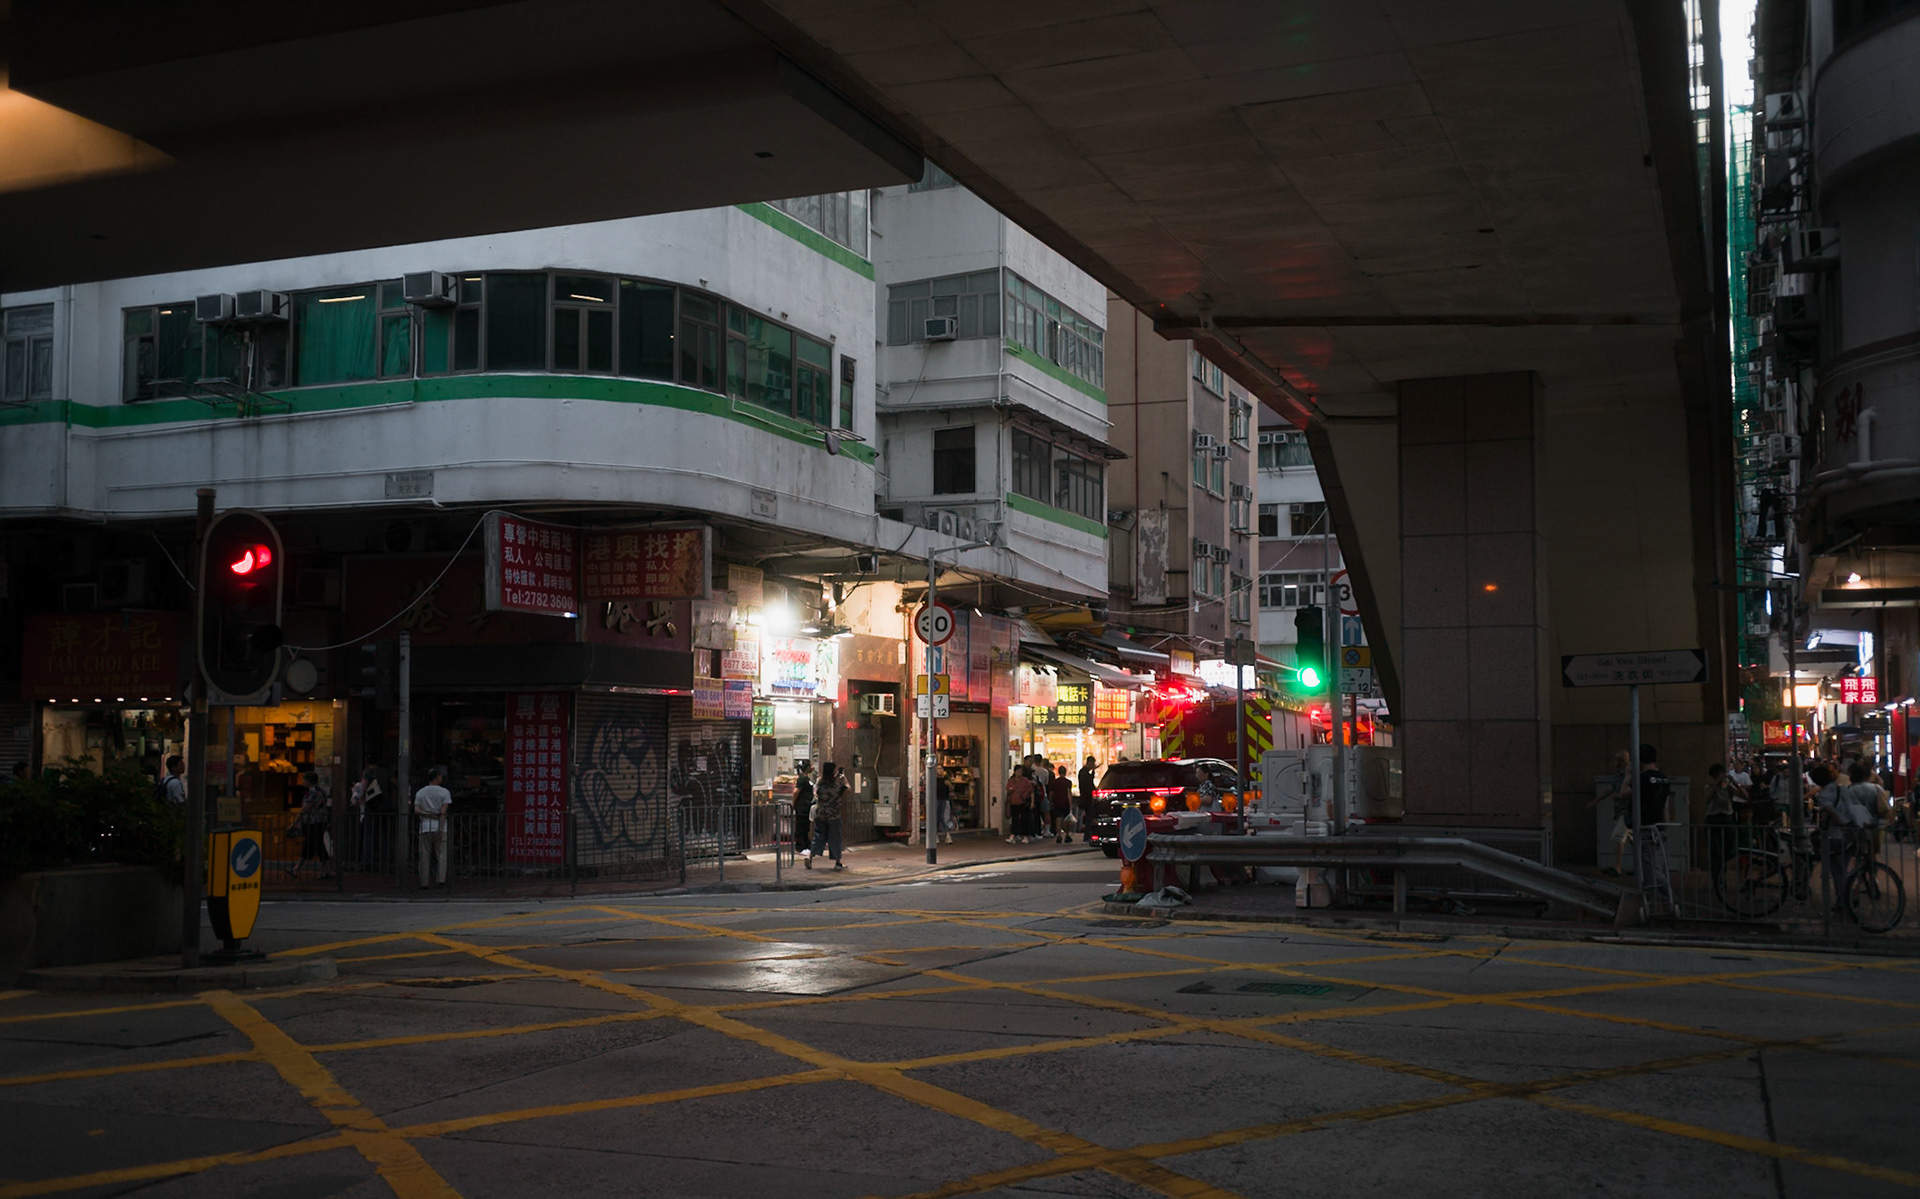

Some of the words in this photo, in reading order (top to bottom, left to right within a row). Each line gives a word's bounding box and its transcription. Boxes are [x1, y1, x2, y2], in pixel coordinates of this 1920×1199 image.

[504, 523, 572, 552] 專營中港兩地
[550, 594, 573, 609] 3600
[922, 616, 949, 632] 30
[48, 618, 162, 655] 譚才記
[131, 655, 161, 671] KEE
[1597, 658, 1612, 667] Sai
[1616, 658, 1634, 666] Yee
[1637, 656, 1668, 665] Street
[1358, 669, 1363, 678] 7
[1613, 670, 1654, 681] 洗衣街
[1358, 683, 1368, 691] 12
[516, 695, 560, 720] 專營
[551, 724, 561, 835] 中港兩地私人公司
